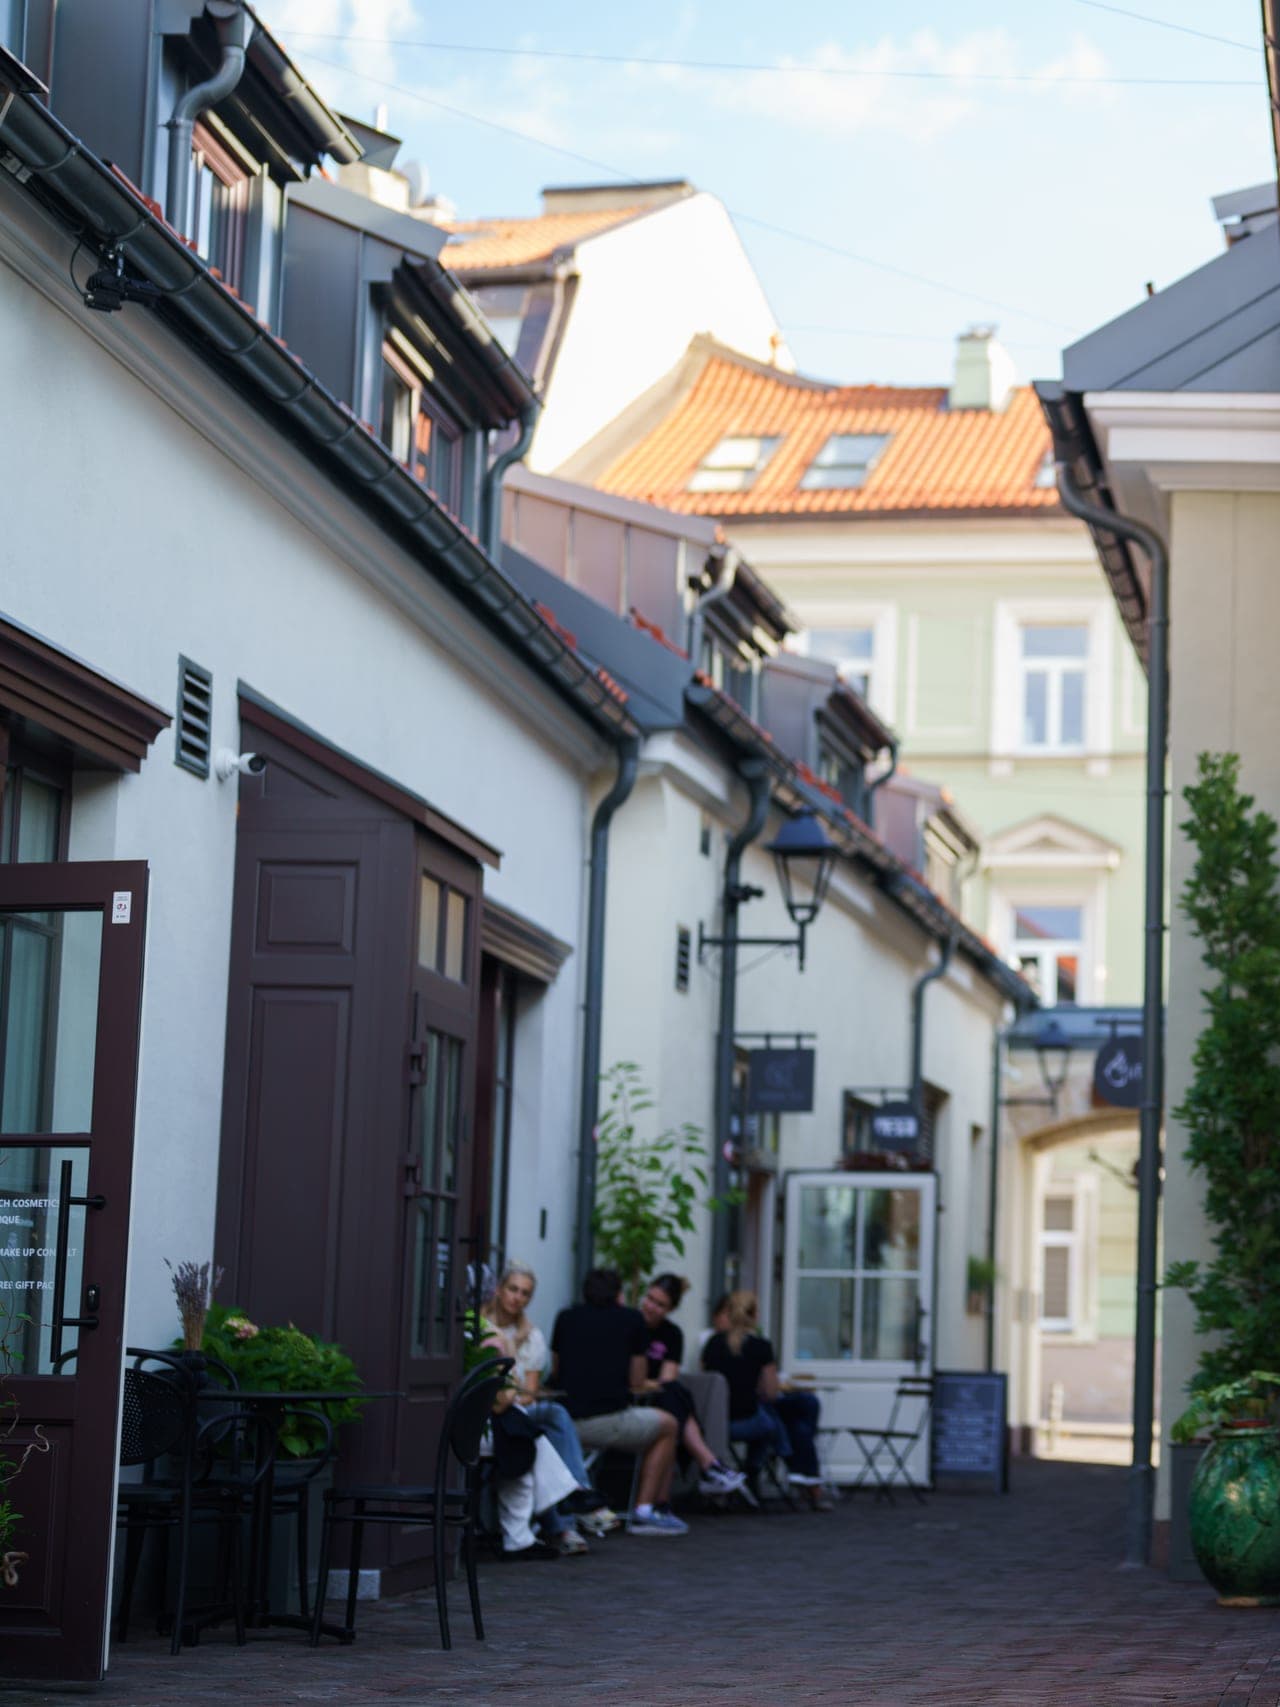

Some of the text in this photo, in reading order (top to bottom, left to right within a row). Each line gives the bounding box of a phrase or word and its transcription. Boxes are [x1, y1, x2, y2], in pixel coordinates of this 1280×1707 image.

[23, 1248, 35, 1257] UP
[36, 1248, 77, 1257] CONLT
[15, 1281, 35, 1290] GIFT
[37, 1281, 54, 1290] PAC
